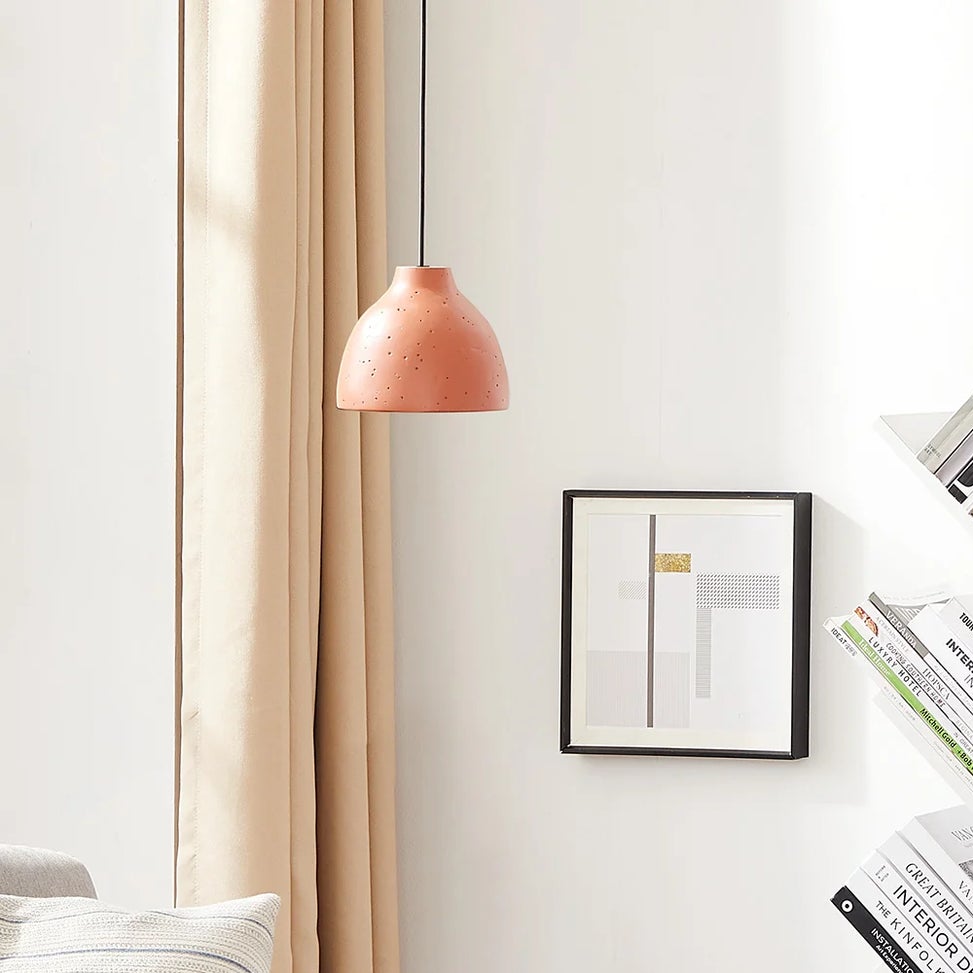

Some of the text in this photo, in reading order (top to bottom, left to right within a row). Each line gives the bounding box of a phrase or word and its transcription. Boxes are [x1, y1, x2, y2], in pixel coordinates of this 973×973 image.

[886, 611, 917, 647] VERANDA
[886, 643, 906, 665] COOKING
[905, 663, 931, 693] SOUTHERN
[930, 692, 946, 708] HOME
[897, 670, 922, 697] HOTEL
[922, 669, 950, 700] HOPSCA
[919, 709, 944, 735] Mitchell
[941, 732, 957, 749] Gold
[960, 739, 973, 756] GREAT
[951, 828, 973, 840] VAN
[905, 863, 942, 898] GREAT
[876, 900, 891, 918] THE
[893, 884, 960, 959] INTERIOR
